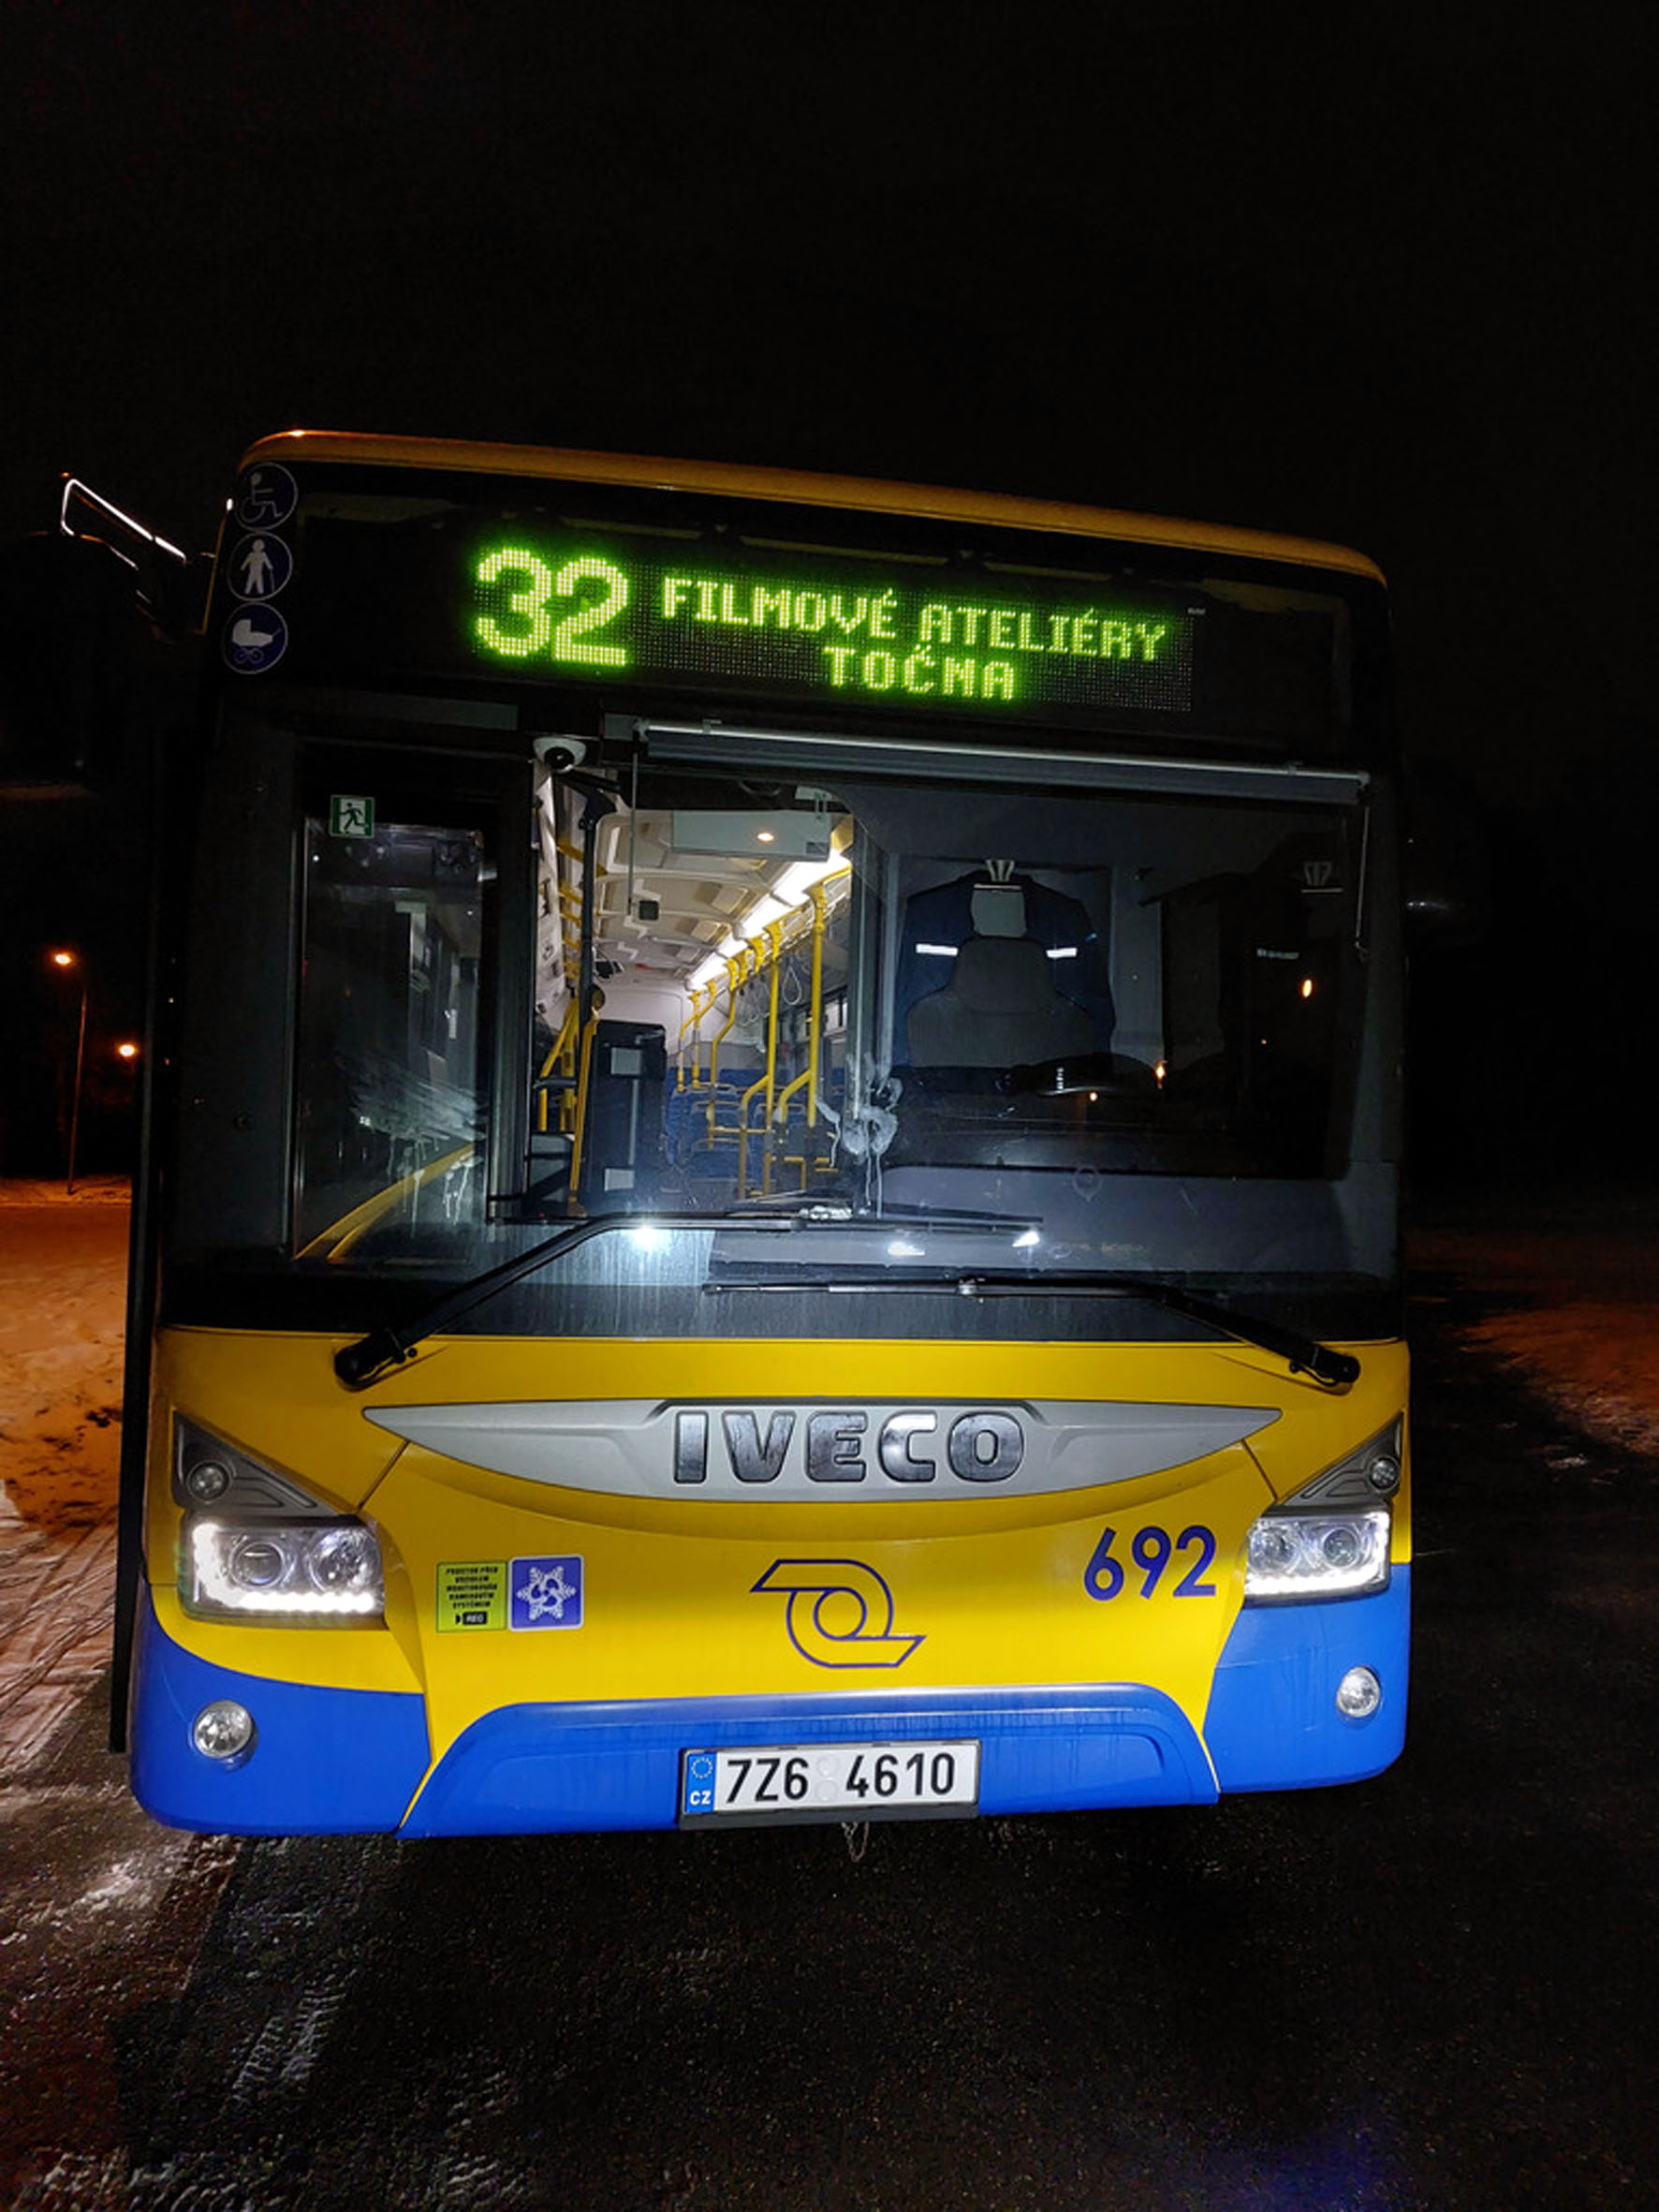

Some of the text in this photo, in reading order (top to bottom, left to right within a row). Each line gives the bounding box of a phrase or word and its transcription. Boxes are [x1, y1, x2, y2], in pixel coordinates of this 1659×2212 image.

[476, 547, 629, 667] 32
[662, 575, 1166, 661] FILMOVÉ ATELIÉRY
[822, 643, 1015, 700] TOČNA
[672, 1409, 1025, 1484] IVECO
[1083, 1524, 1216, 1601] 692
[689, 1790, 712, 1806] CZ
[727, 1752, 956, 1804] 7Z6 4610
